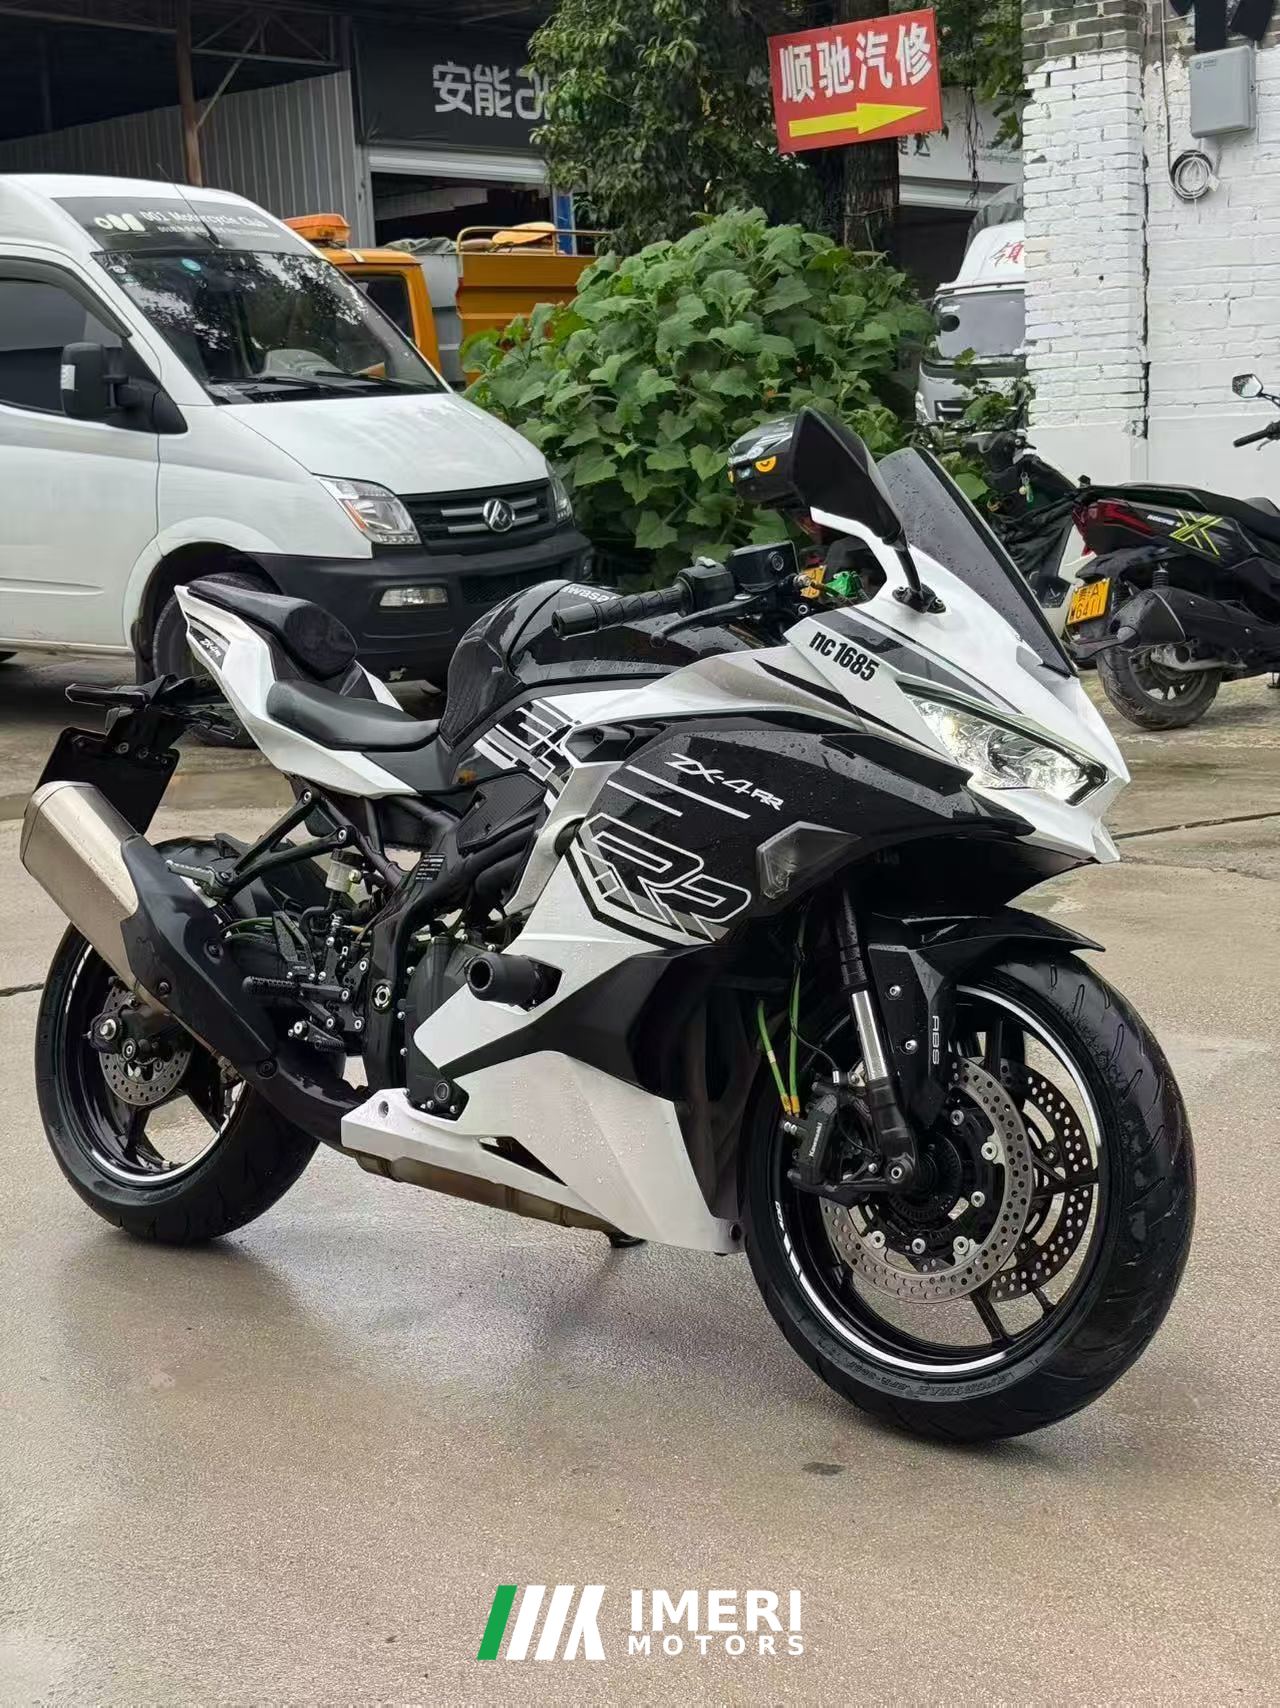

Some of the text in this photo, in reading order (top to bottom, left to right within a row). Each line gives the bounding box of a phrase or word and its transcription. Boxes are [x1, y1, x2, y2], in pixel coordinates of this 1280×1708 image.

[779, 22, 933, 103] 顺驰汽修
[664, 753, 784, 811] ZX-4RR
[932, 1015, 940, 1065] ABS
